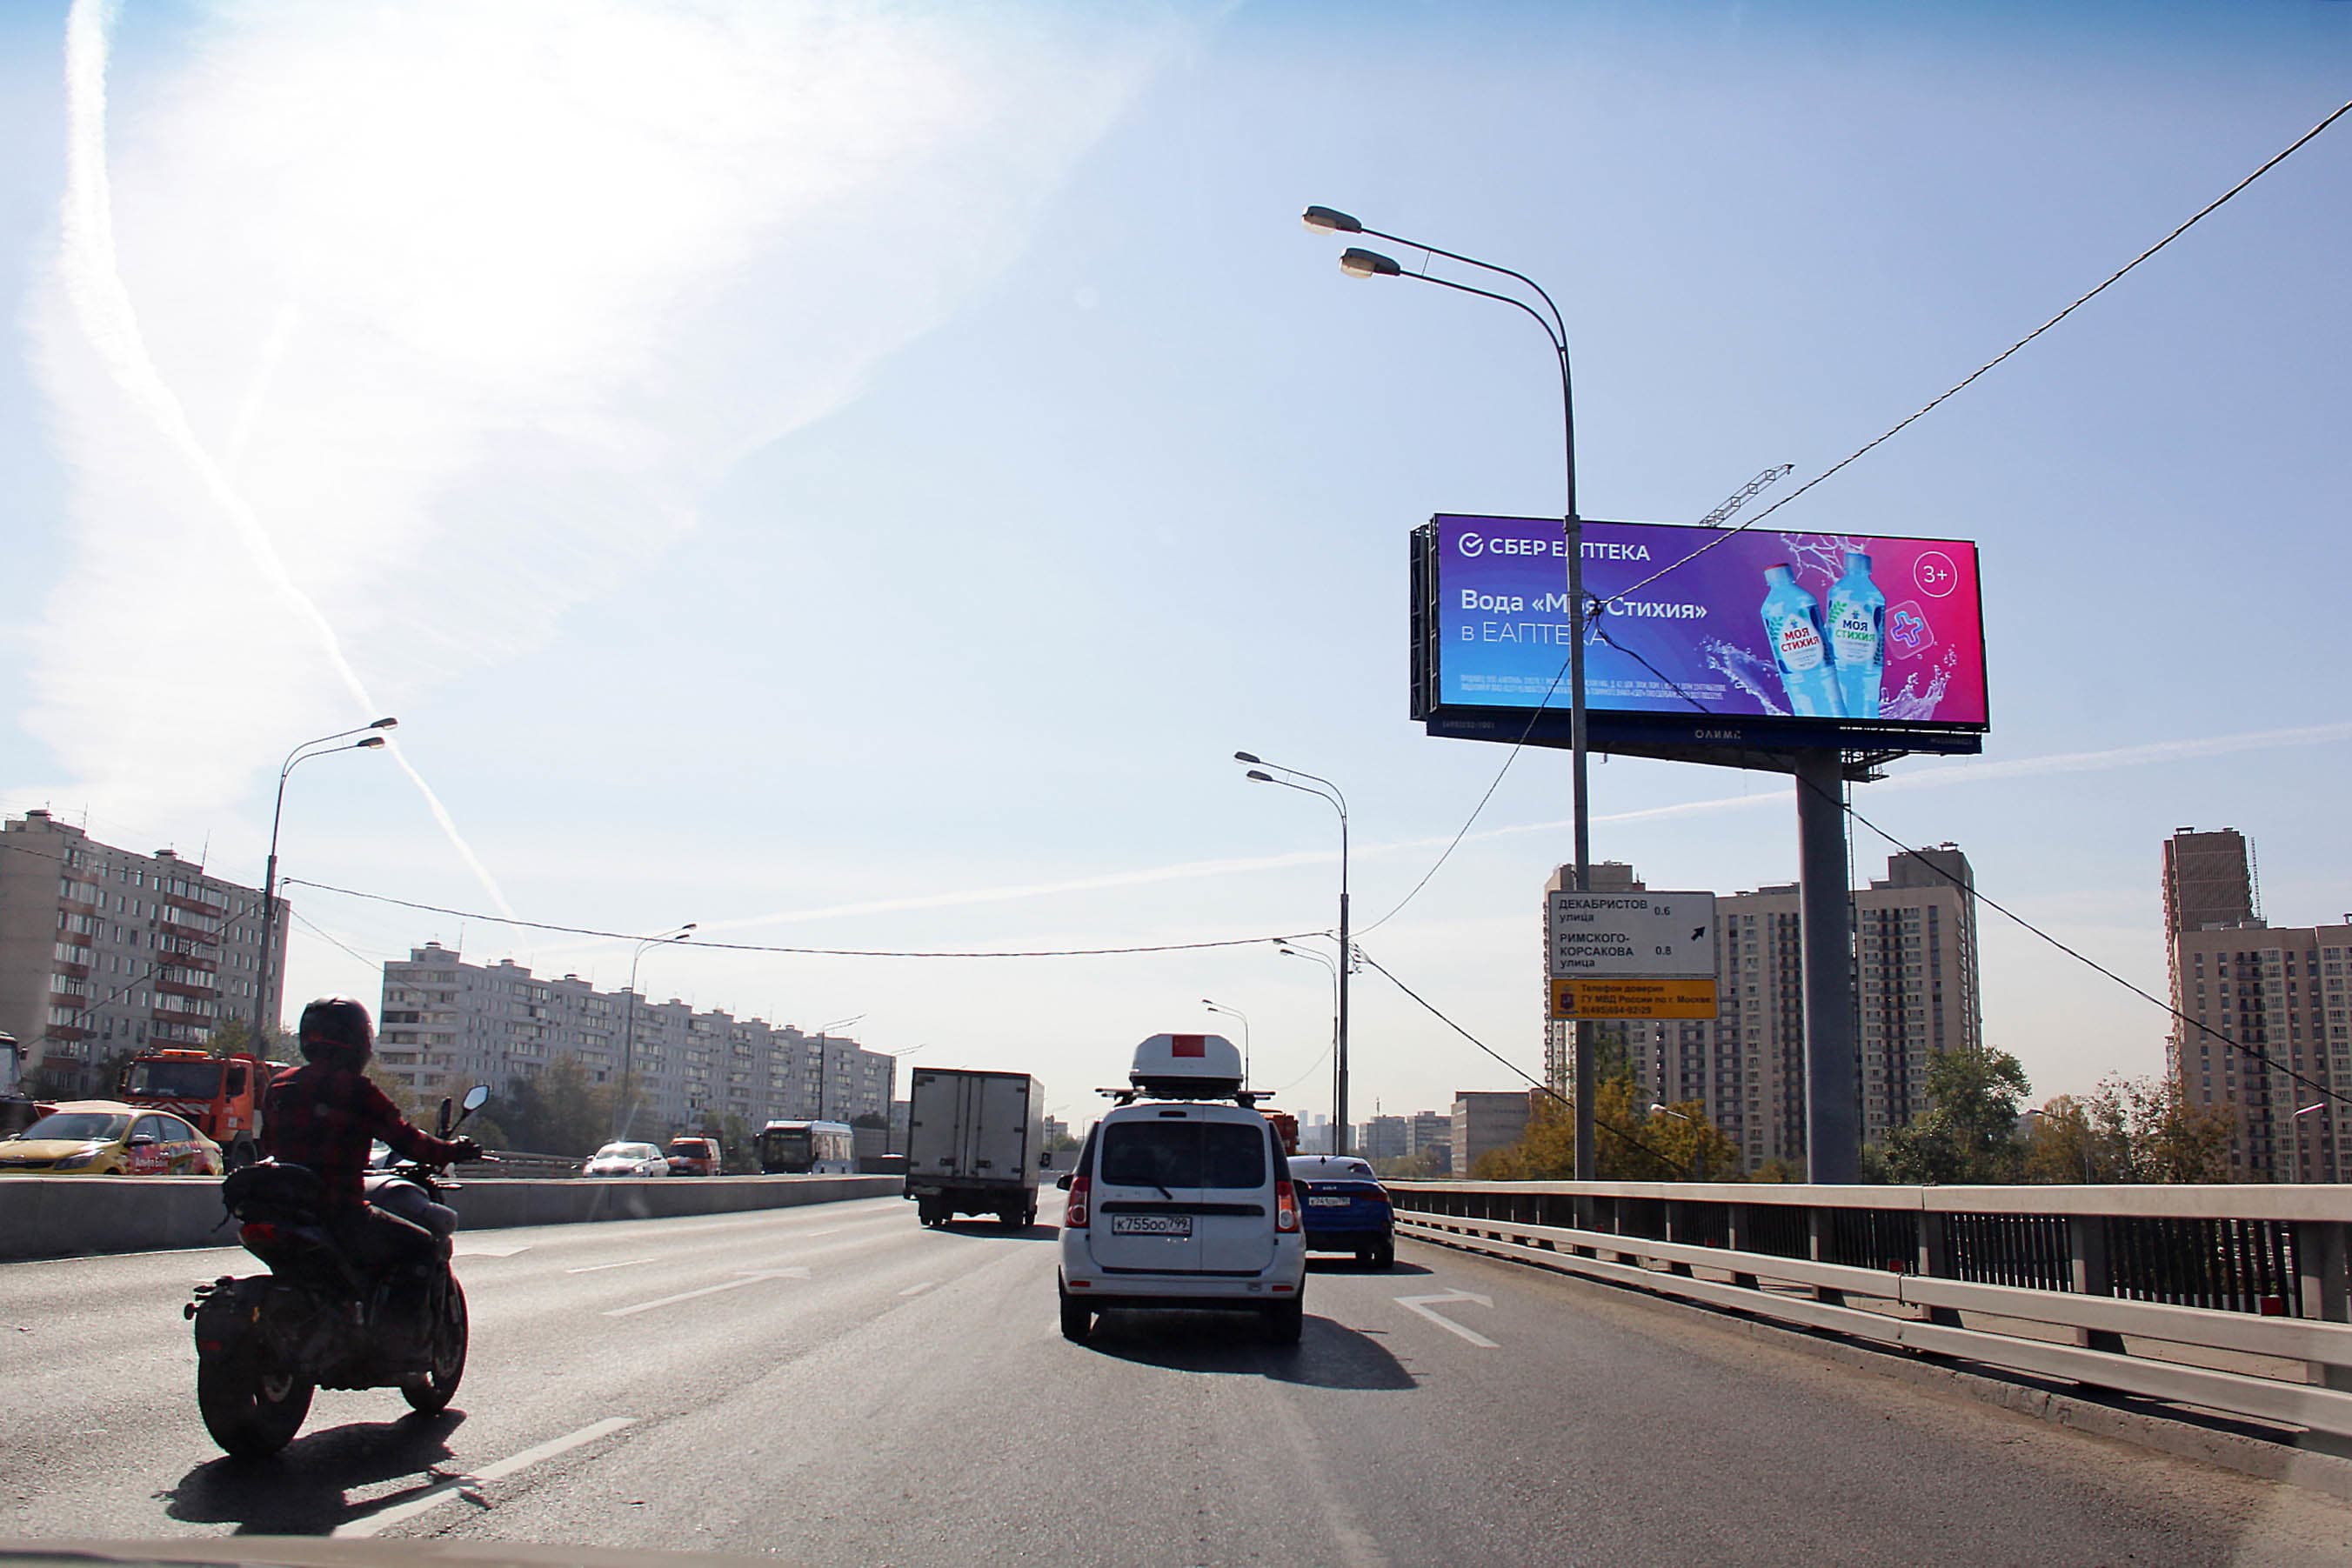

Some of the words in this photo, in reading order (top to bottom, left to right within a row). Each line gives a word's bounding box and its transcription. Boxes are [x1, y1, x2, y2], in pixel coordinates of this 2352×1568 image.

[1489, 537, 1547, 556] СБЕР
[1552, 540, 1651, 561] ЕПТЕКА
[1922, 564, 1948, 584] 3+
[1461, 589, 1523, 614] Вода
[1607, 596, 1707, 619] Стихия»
[1842, 619, 1868, 631] МОЯ
[1483, 621, 1608, 647] ЕАПТЕА
[1784, 627, 1810, 640] МОЯ
[1835, 629, 1875, 642] СТИХИЯ
[1781, 637, 1821, 652] СТИХИЯ
[1559, 899, 1647, 910] ДЕКАБРИСТОВ
[1654, 906, 1671, 916] 0.6
[1559, 913, 1594, 924] улица
[1560, 933, 1630, 944] РИМСКОГО-
[1560, 946, 1634, 957] КОРСАКОВА
[1655, 945, 1672, 956] 0.8
[1560, 959, 1595, 970] улица
